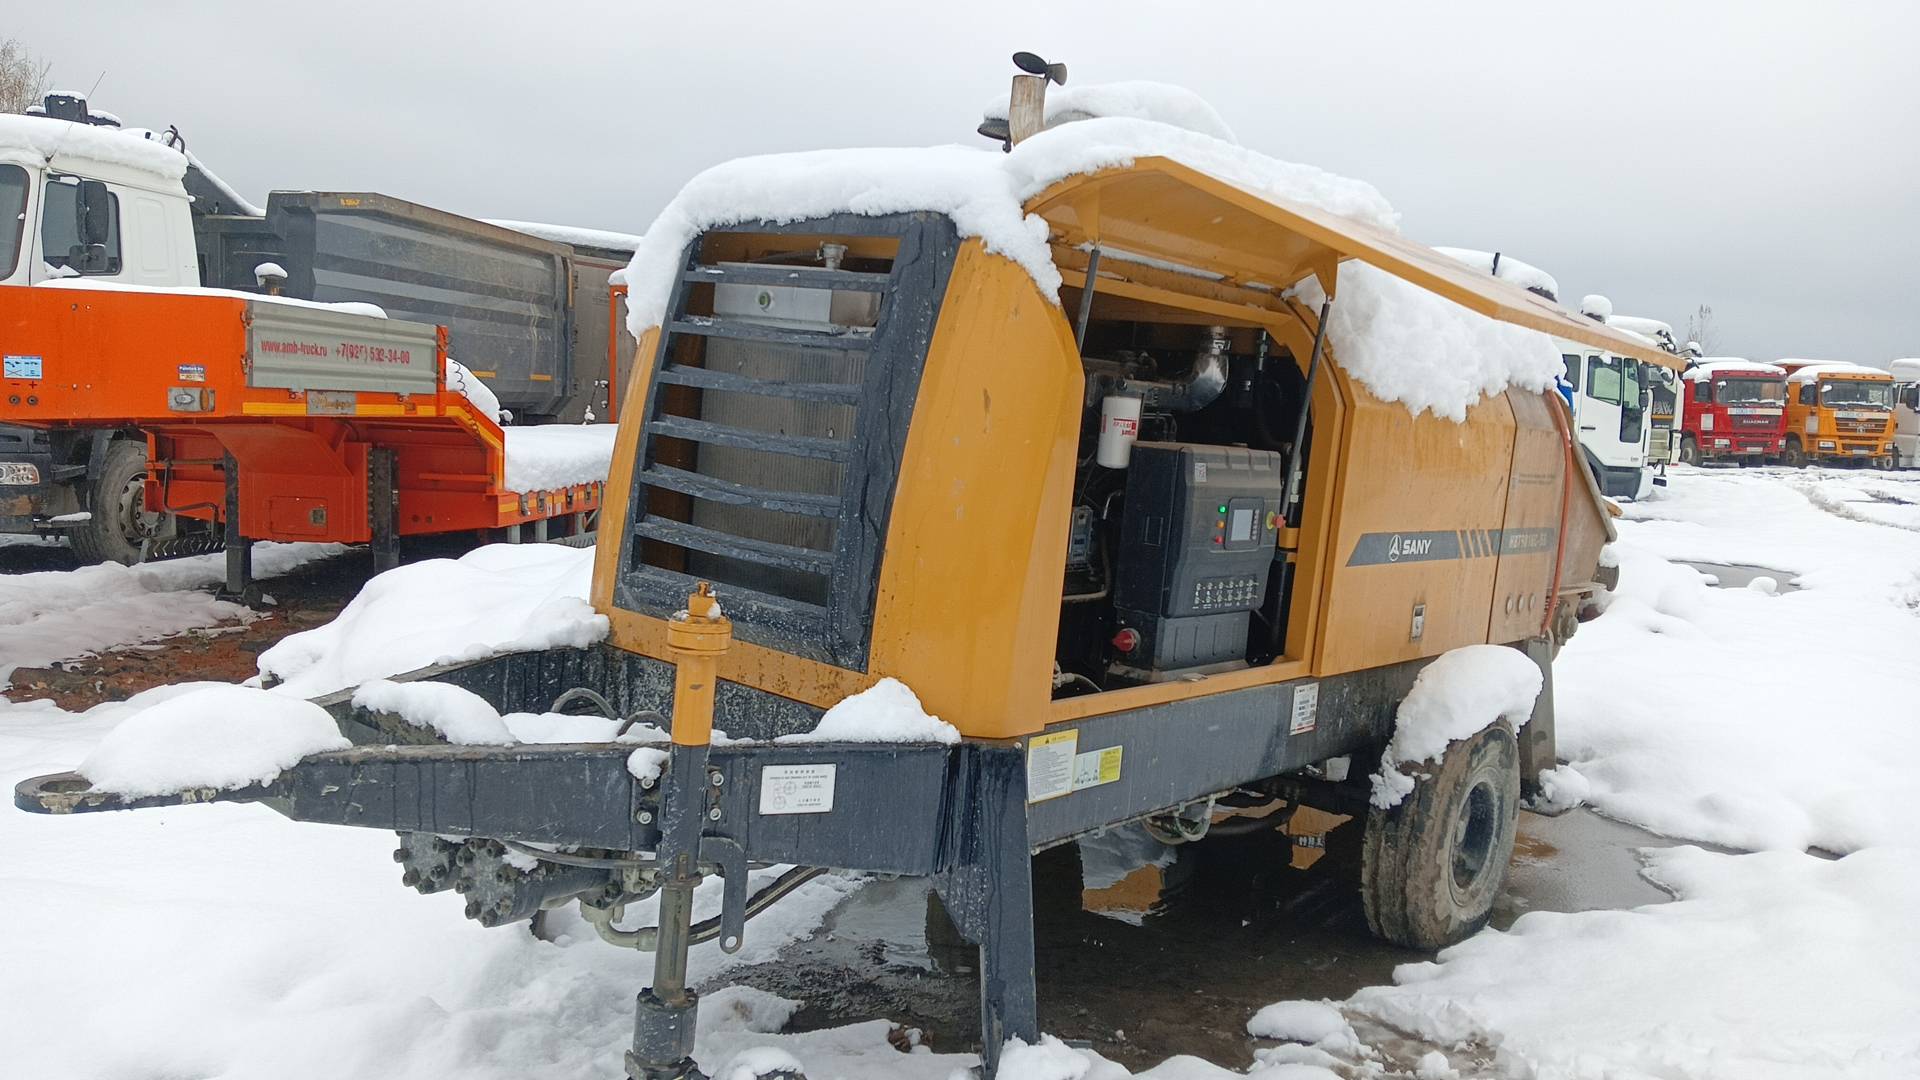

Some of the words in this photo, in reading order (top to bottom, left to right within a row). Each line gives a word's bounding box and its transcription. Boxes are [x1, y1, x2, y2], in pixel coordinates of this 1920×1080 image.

[261, 340, 328, 357] www.amb-truck.ru
[1652, 400, 1674, 415] FAW
[1402, 539, 1432, 555] SANY
